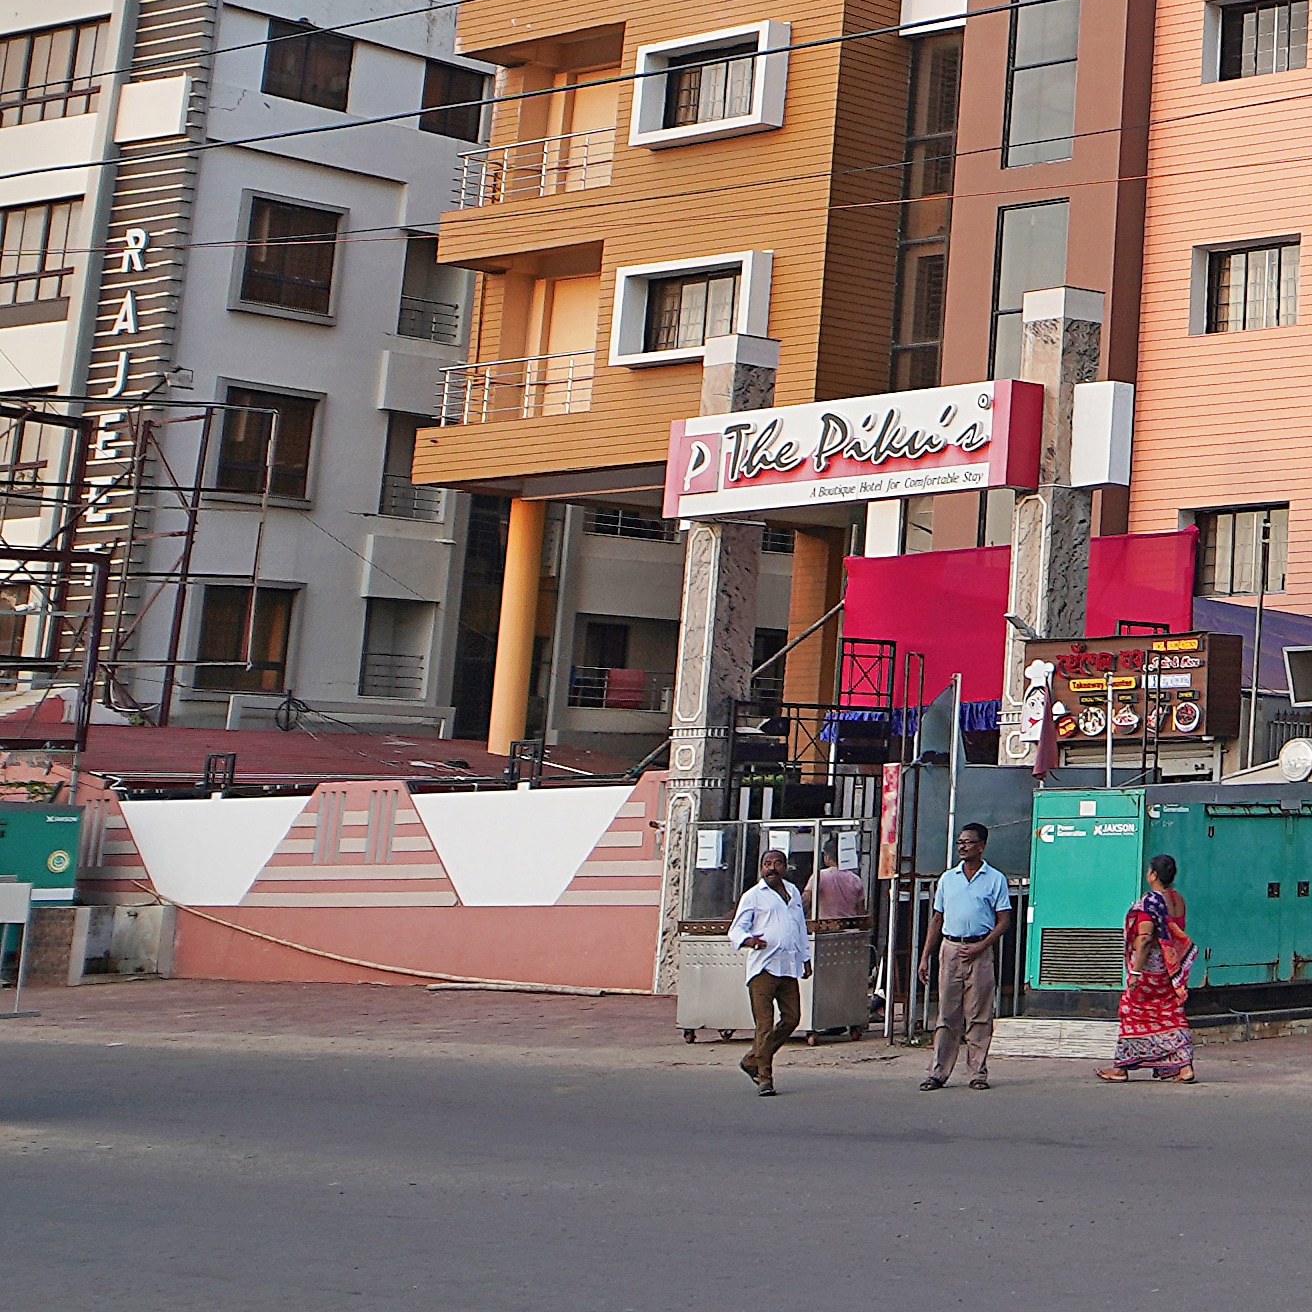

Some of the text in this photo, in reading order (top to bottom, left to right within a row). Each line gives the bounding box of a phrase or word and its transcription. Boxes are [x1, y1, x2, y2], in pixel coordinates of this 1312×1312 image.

[724, 404, 991, 483] The Piku's
[818, 485, 856, 498] Boutique
[859, 480, 883, 493] Hotel
[886, 478, 901, 493] for
[904, 472, 960, 489] Comfortable
[962, 471, 984, 484] Stay
[1102, 823, 1135, 833] JAKSON
